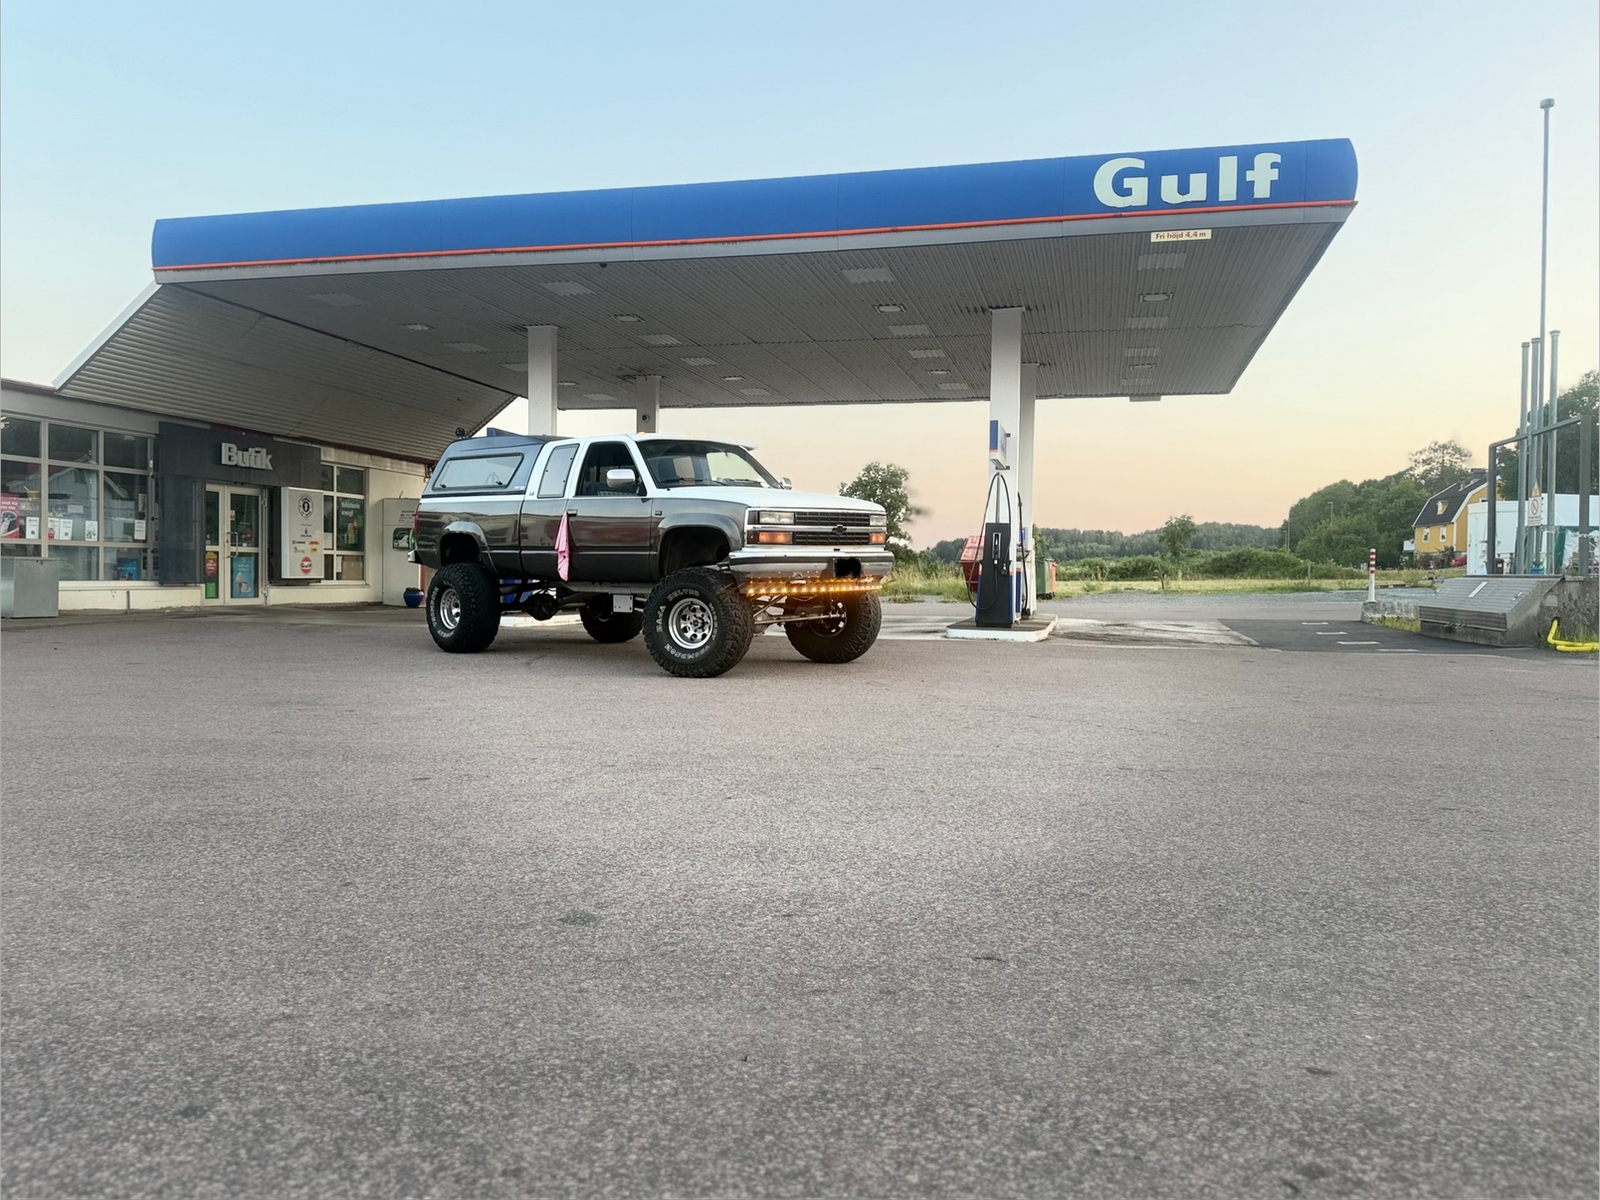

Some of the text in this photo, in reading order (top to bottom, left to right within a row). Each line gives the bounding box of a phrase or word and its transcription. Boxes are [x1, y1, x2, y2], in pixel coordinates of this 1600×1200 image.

[1093, 152, 1282, 208] Gulf
[1167, 231, 1184, 240] höjd
[1185, 231, 1198, 239] 4,4
[221, 442, 273, 470] Butik
[666, 588, 699, 602] BELTED
